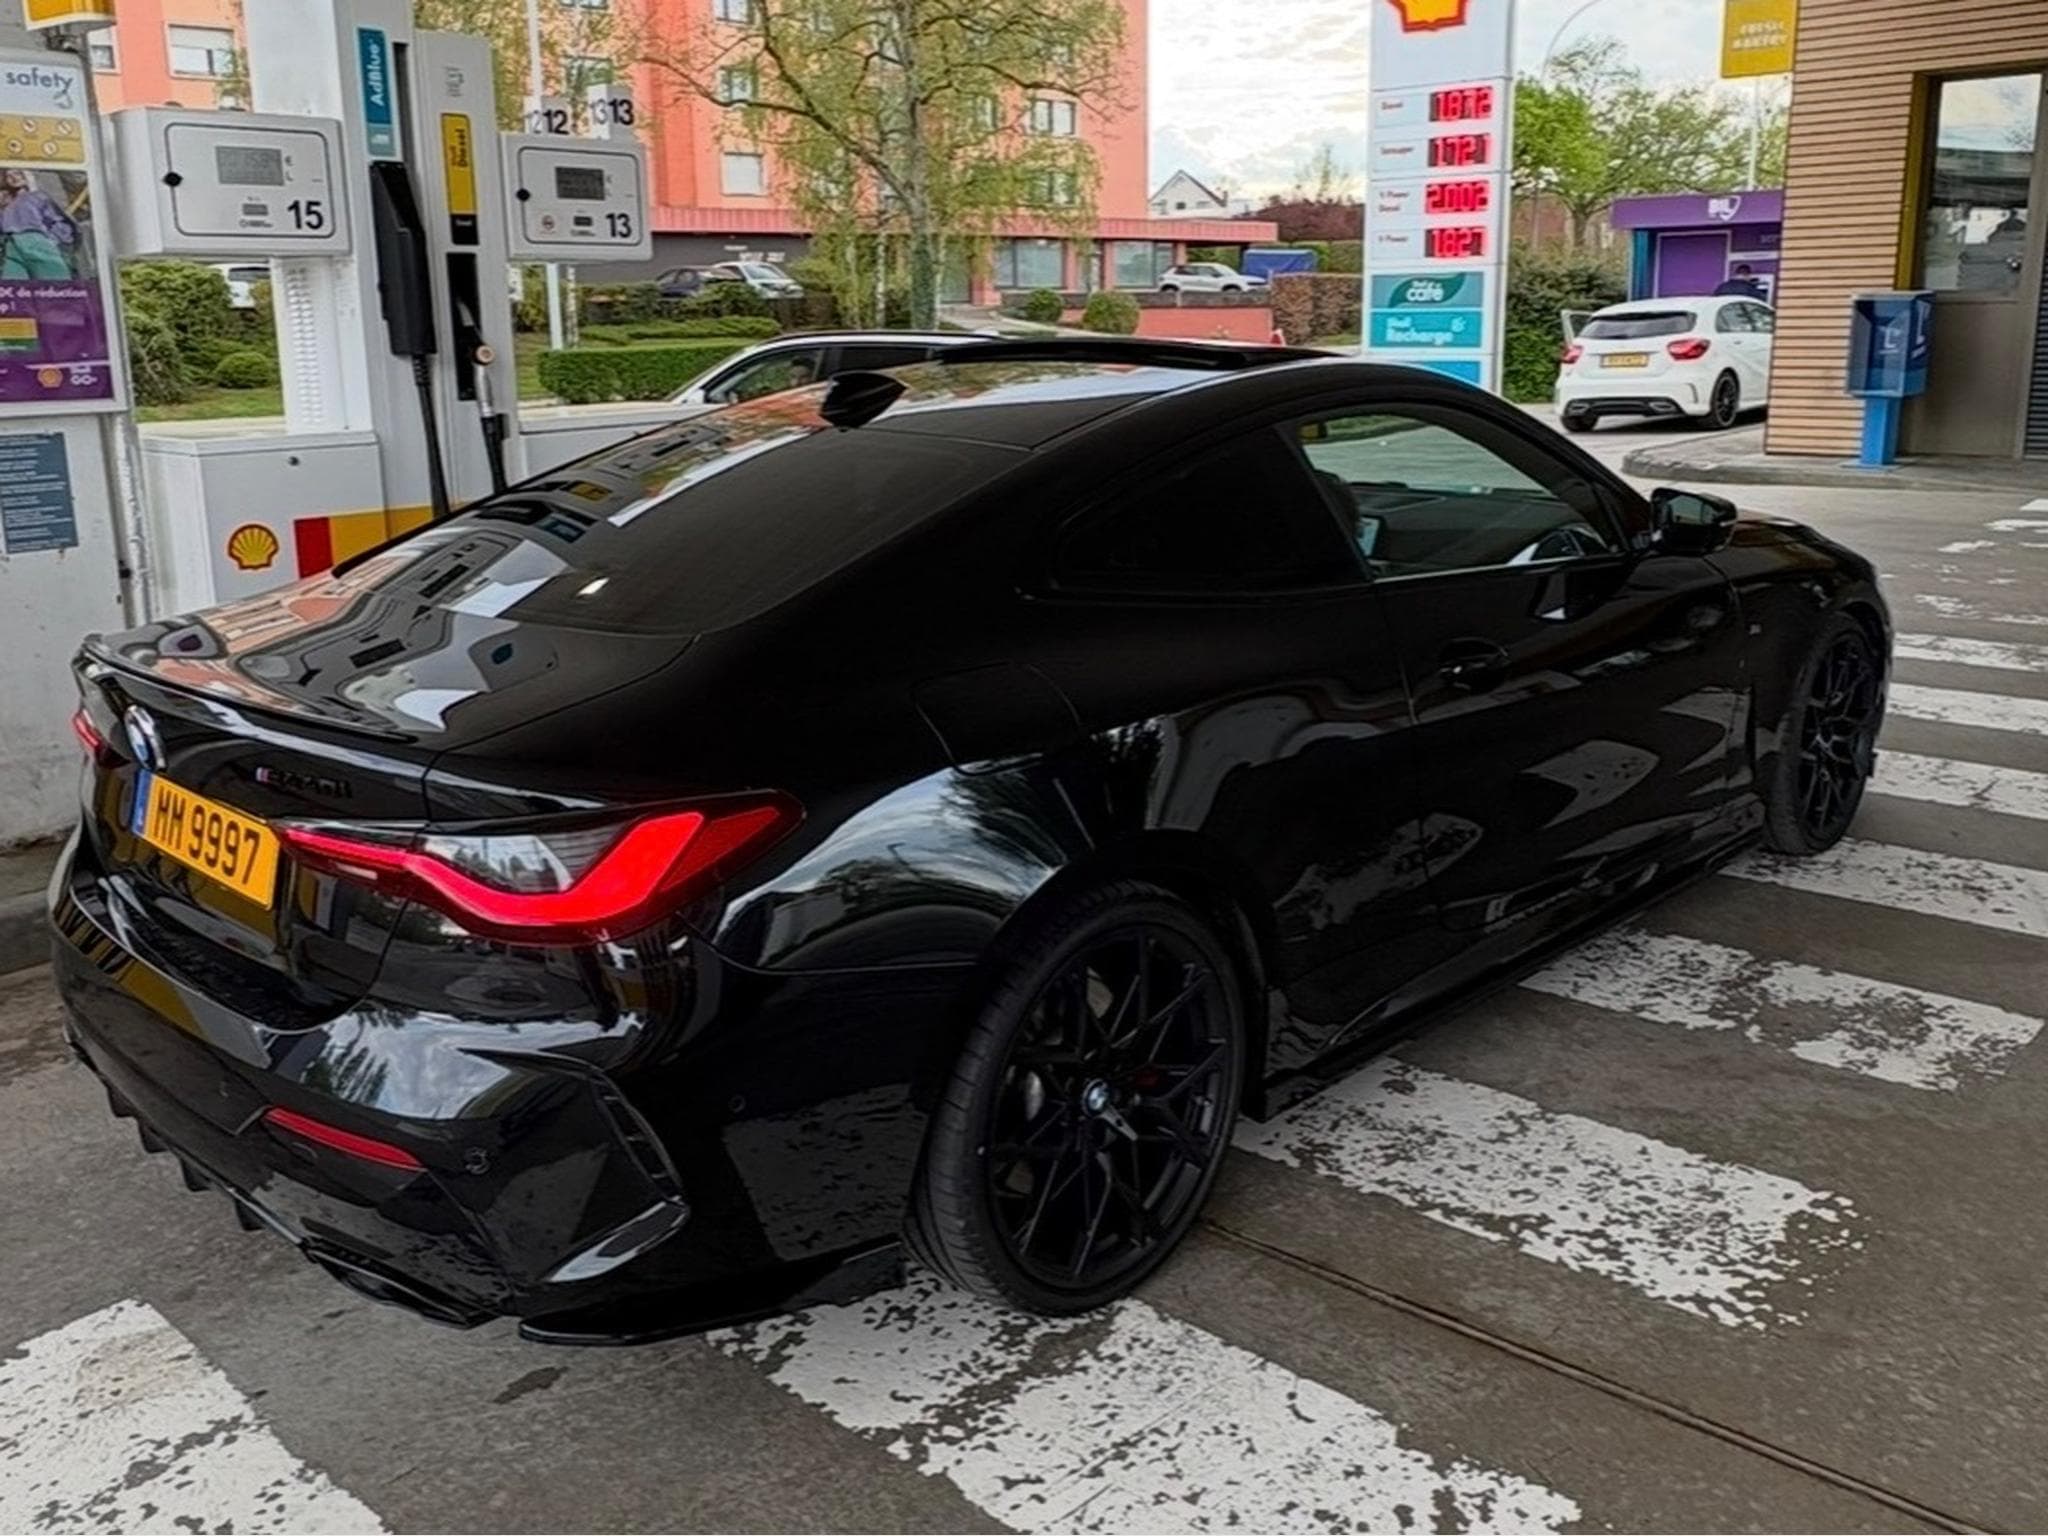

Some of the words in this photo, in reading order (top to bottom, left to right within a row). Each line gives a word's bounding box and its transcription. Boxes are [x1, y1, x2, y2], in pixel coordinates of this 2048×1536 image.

[6, 67, 73, 100] safety
[366, 43, 384, 106] AdBlue
[543, 109, 570, 135] 12
[609, 98, 634, 126] 13
[287, 200, 325, 230] 15
[605, 212, 632, 238] 13
[187, 804, 262, 886] 9997
